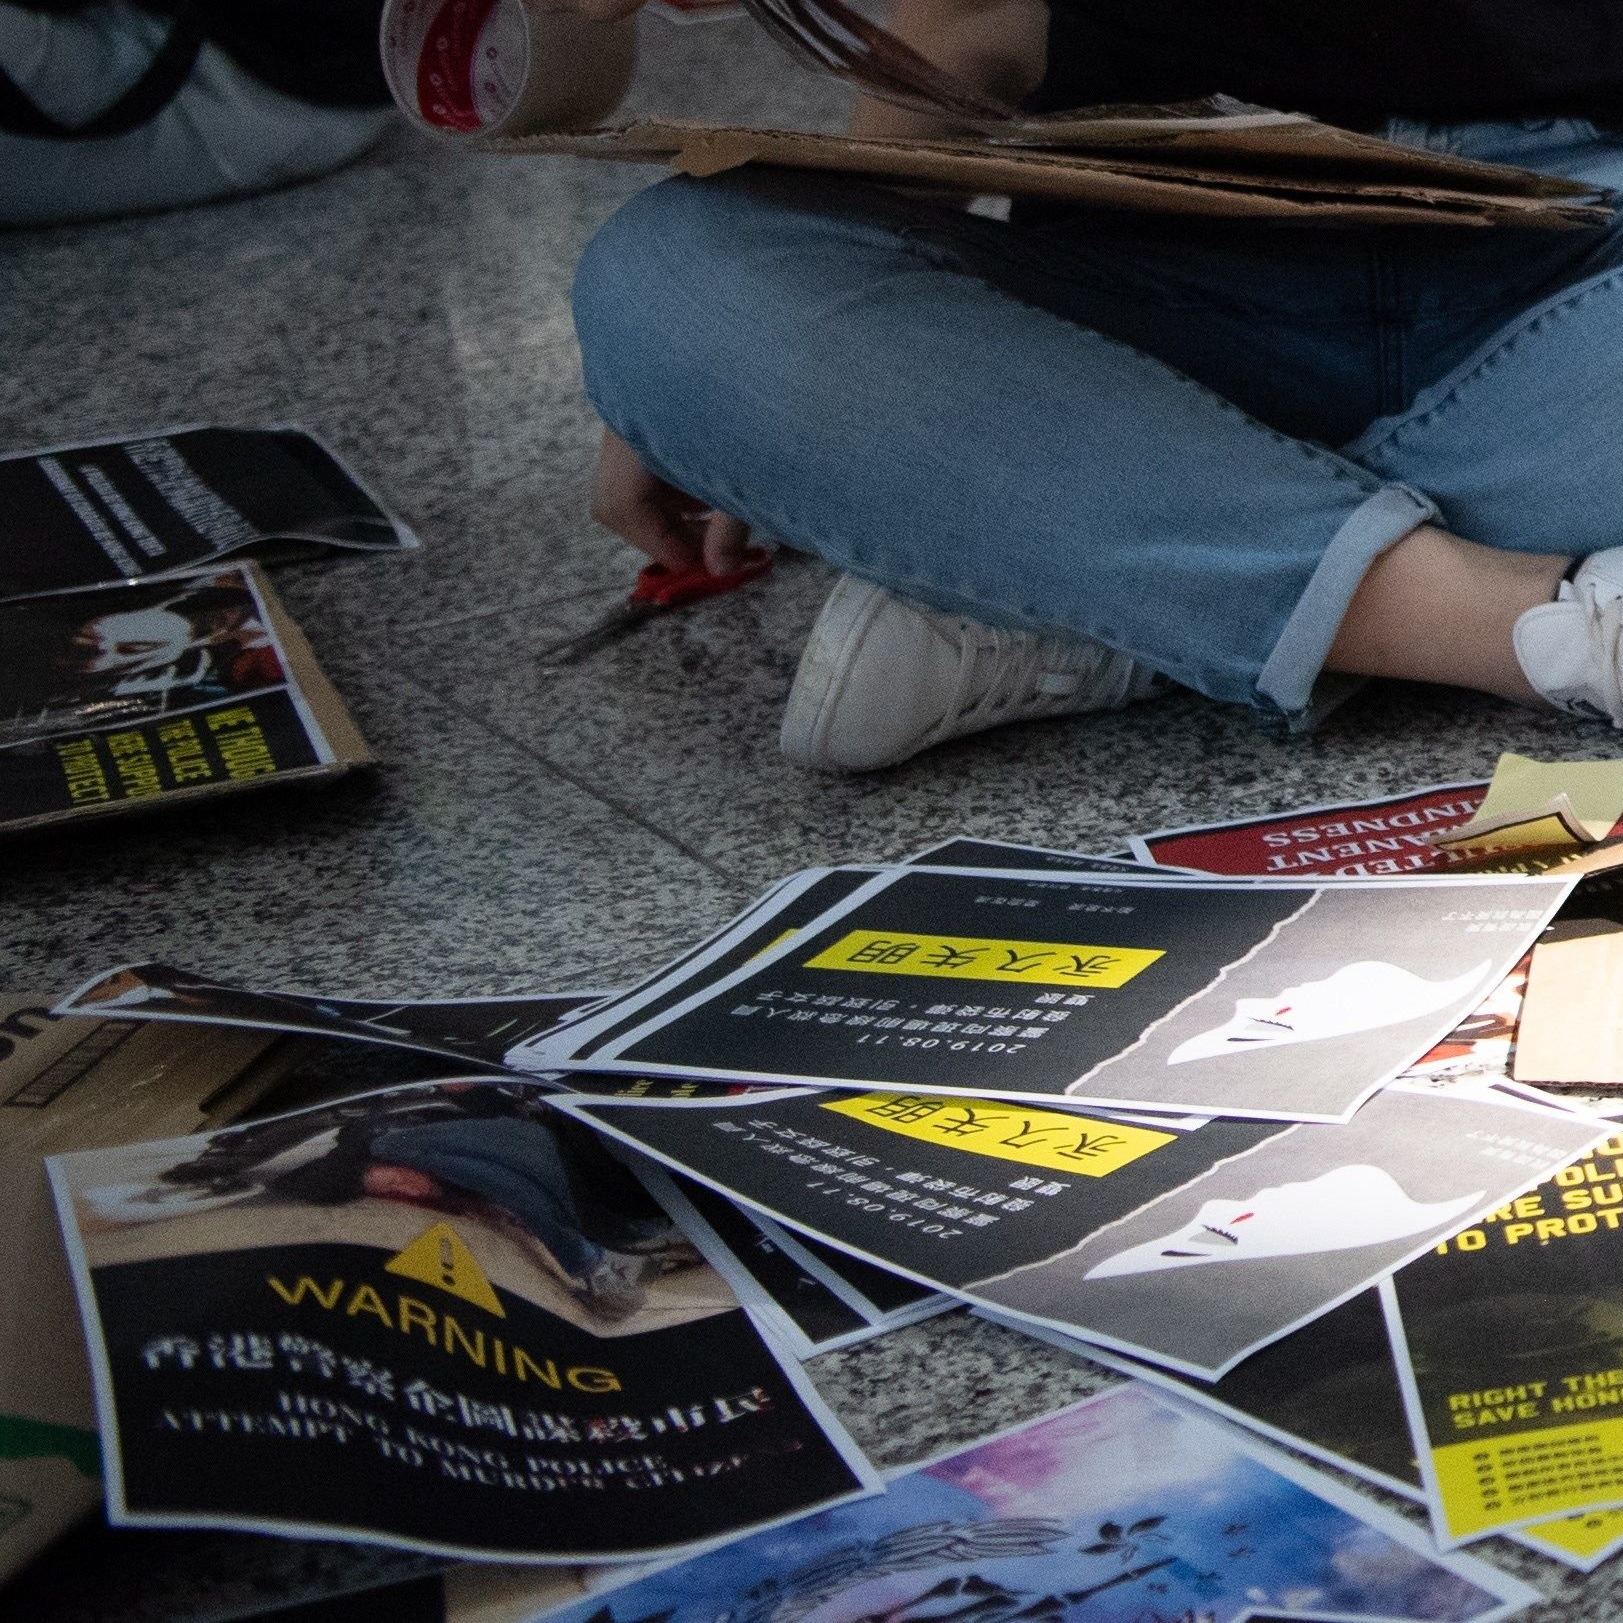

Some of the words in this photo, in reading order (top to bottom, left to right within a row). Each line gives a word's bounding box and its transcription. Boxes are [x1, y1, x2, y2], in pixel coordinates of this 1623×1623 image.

[1262, 799, 1483, 847] INDNESS
[1268, 825, 1454, 871] ANENT
[845, 939, 1124, 981] 永久失明
[855, 1032, 1029, 1057] 2019.08.11
[865, 1097, 1127, 1160] 永久失明
[807, 1181, 963, 1240] 2019.08.11
[1487, 1196, 1544, 1223] RE
[269, 1275, 622, 1394] WARNING
[1449, 1382, 1548, 1410] RIGHT
[1452, 1402, 1539, 1431] SAVE
